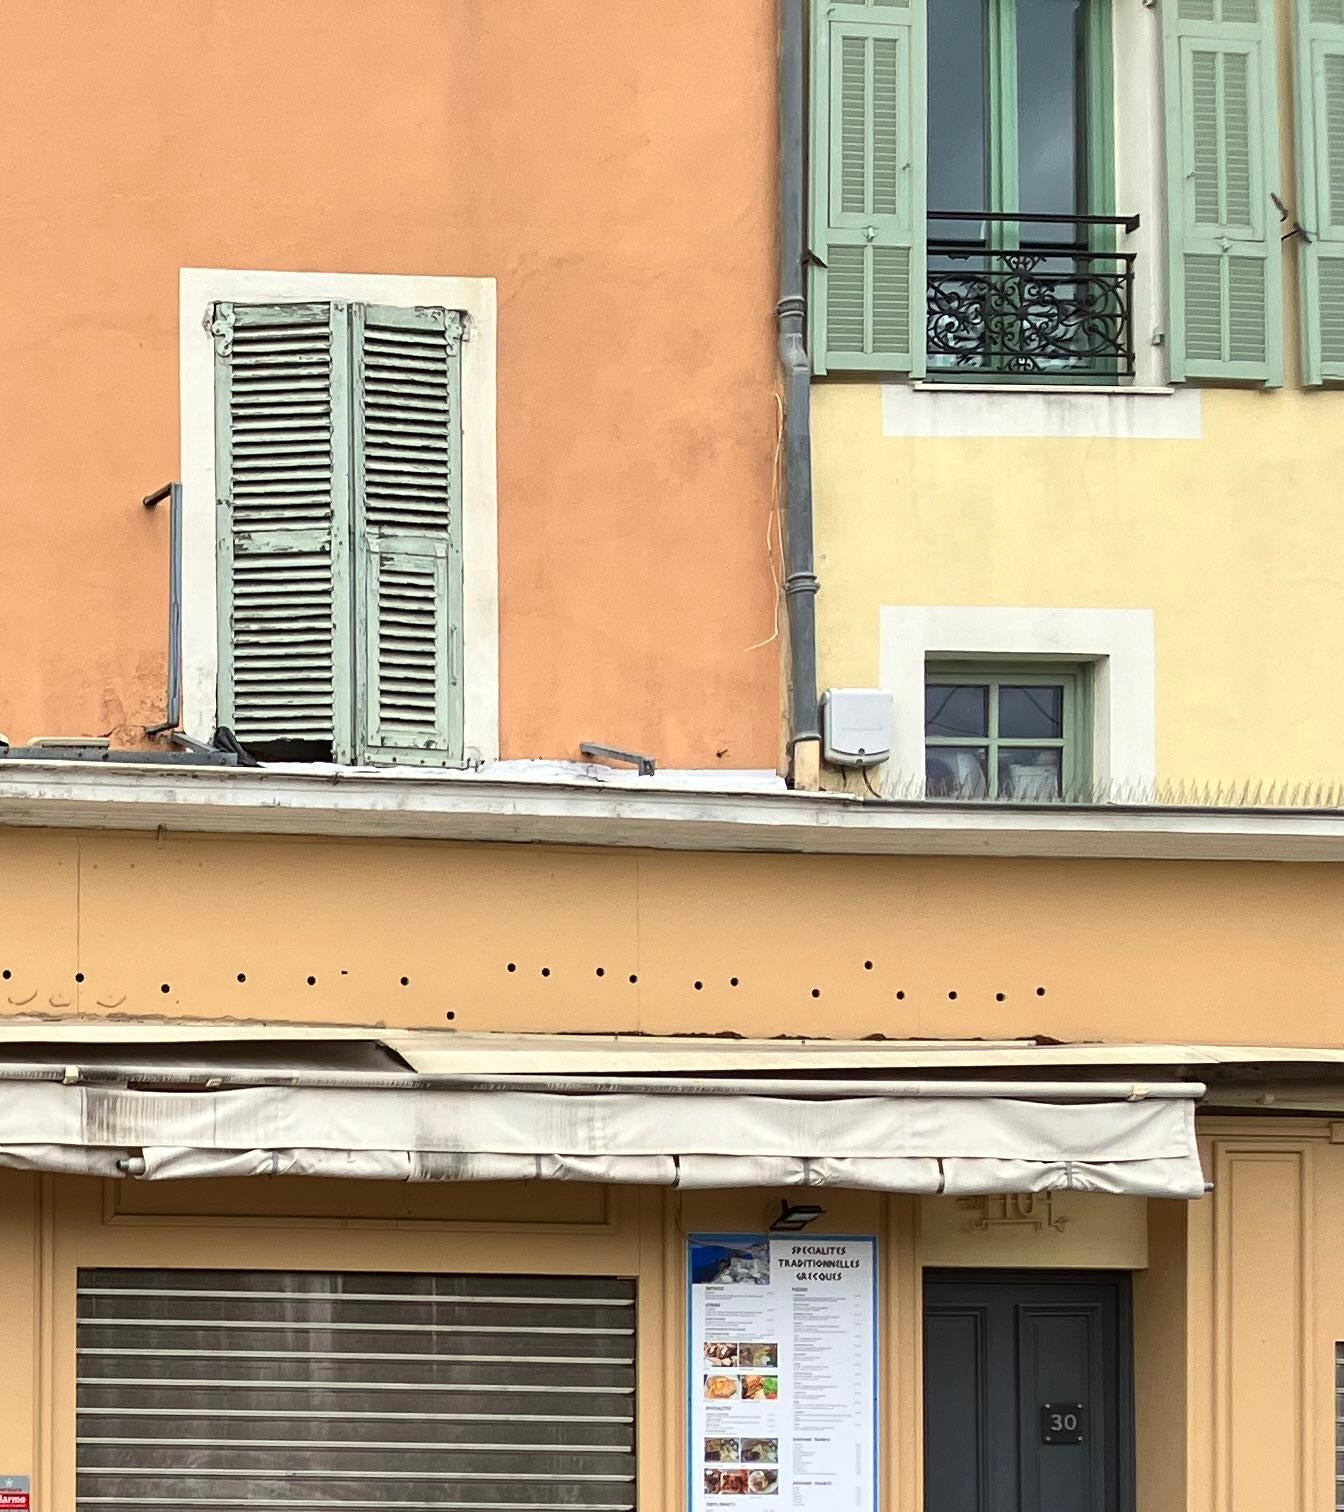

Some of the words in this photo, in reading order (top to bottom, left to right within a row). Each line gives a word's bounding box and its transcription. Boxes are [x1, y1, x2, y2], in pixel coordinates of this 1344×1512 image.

[791, 1246, 846, 1256] SPECIALITES
[778, 1259, 860, 1269] TRADITIONNELLES
[796, 1272, 842, 1281] GRECQUES
[1050, 1413, 1077, 1432] 30
